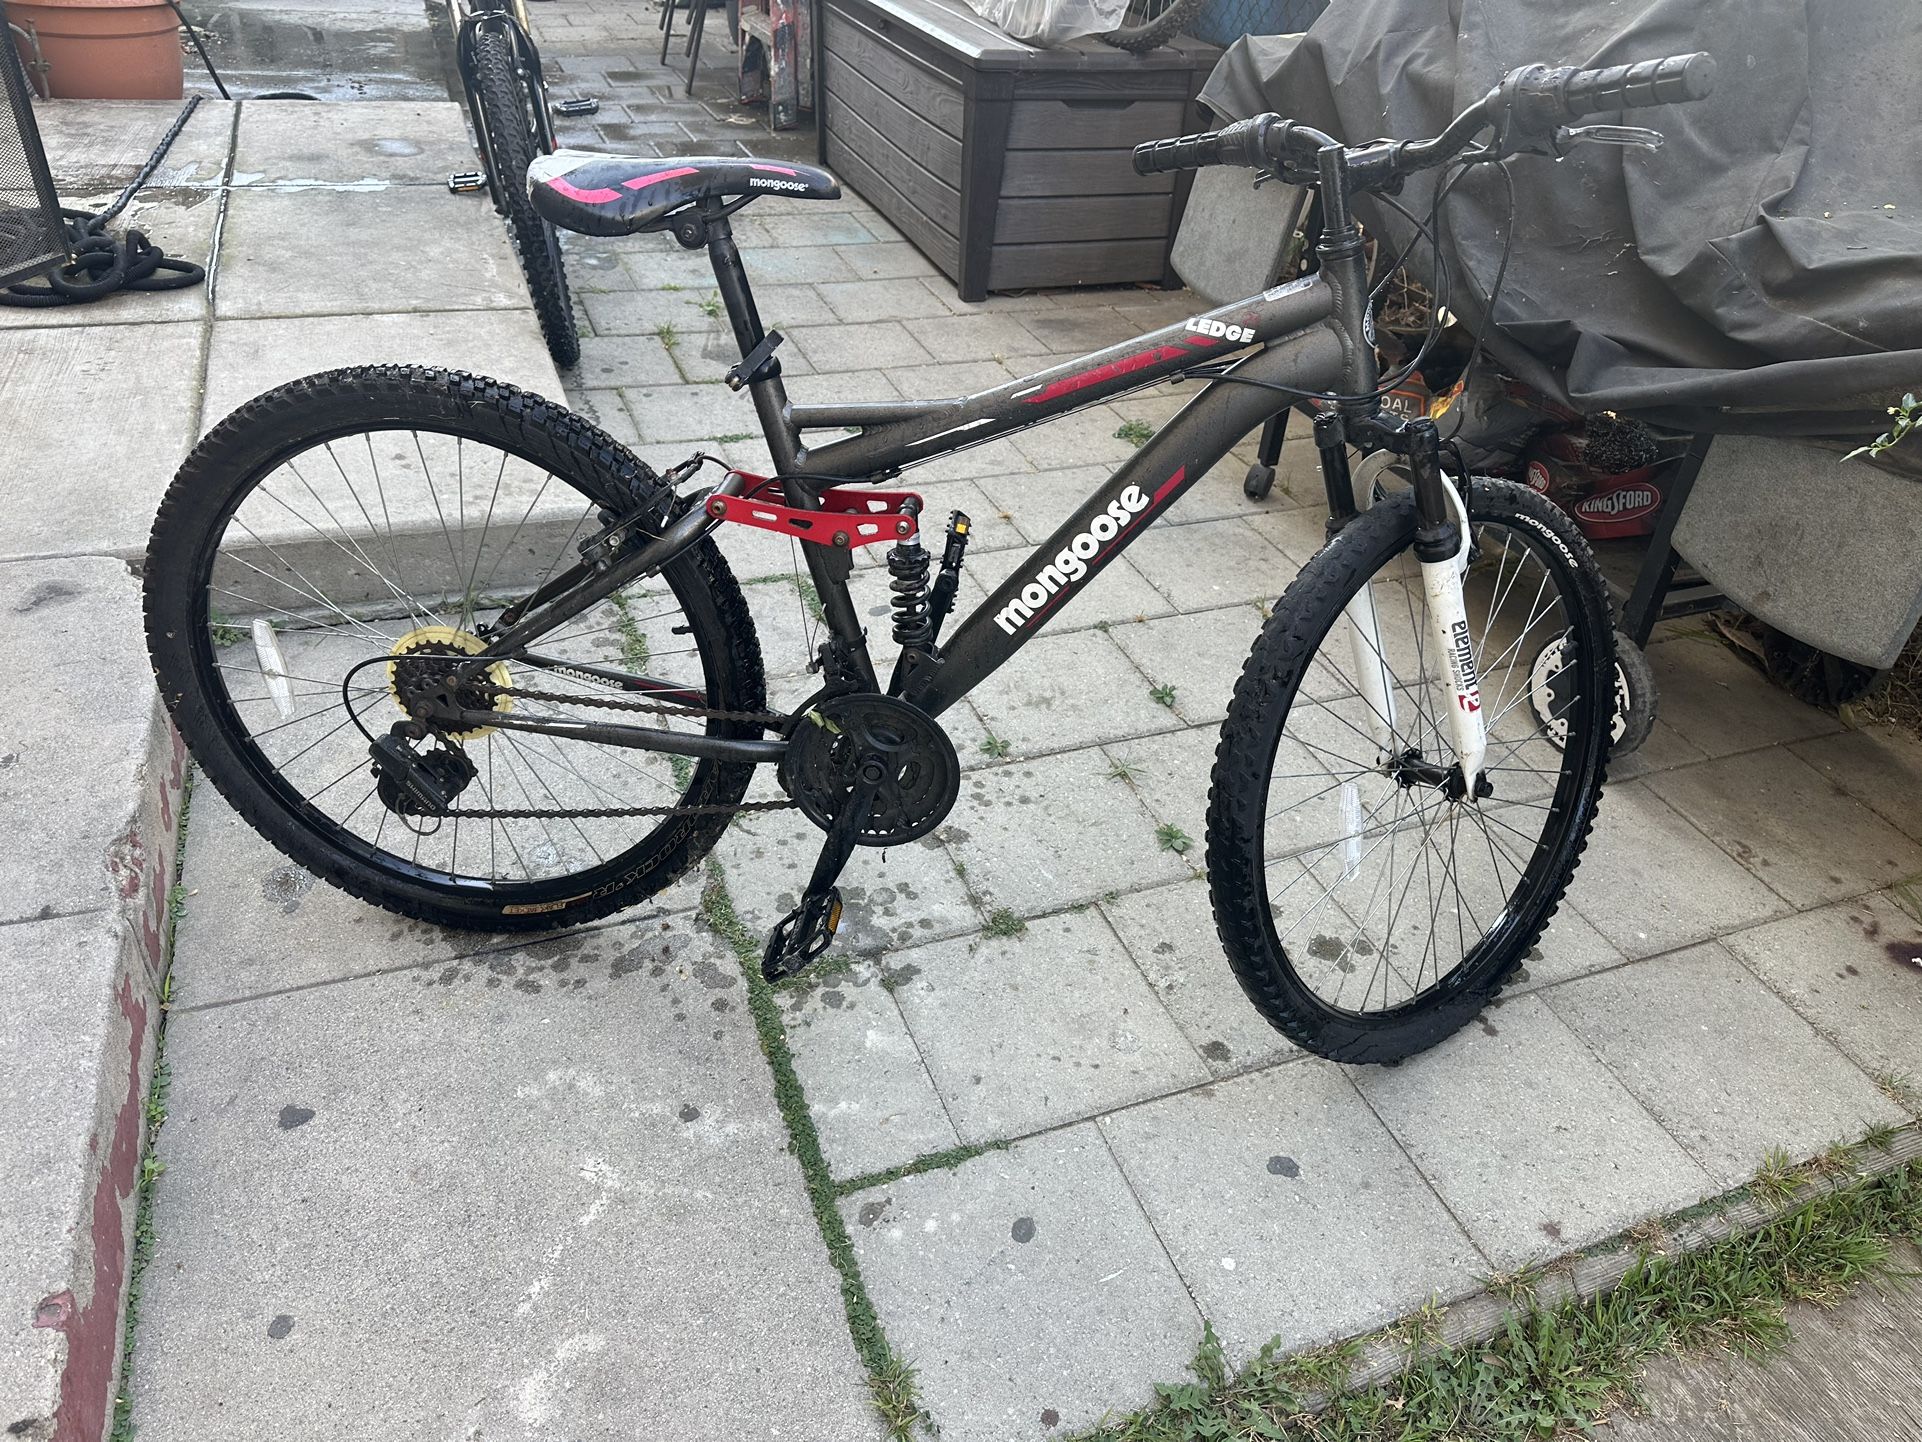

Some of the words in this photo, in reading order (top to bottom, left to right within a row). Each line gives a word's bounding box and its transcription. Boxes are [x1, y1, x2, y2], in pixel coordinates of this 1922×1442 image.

[750, 177, 806, 192] mongoose
[1185, 318, 1256, 343] LEDGE
[1581, 490, 1652, 515] KINGSFORD
[1514, 511, 1579, 568] mongoose
[993, 484, 1150, 635] mongoose
[1448, 649, 1459, 669] RACING
[1451, 620, 1477, 690] element
[553, 665, 624, 690] mongoose
[405, 780, 436, 811] SHIMANO
